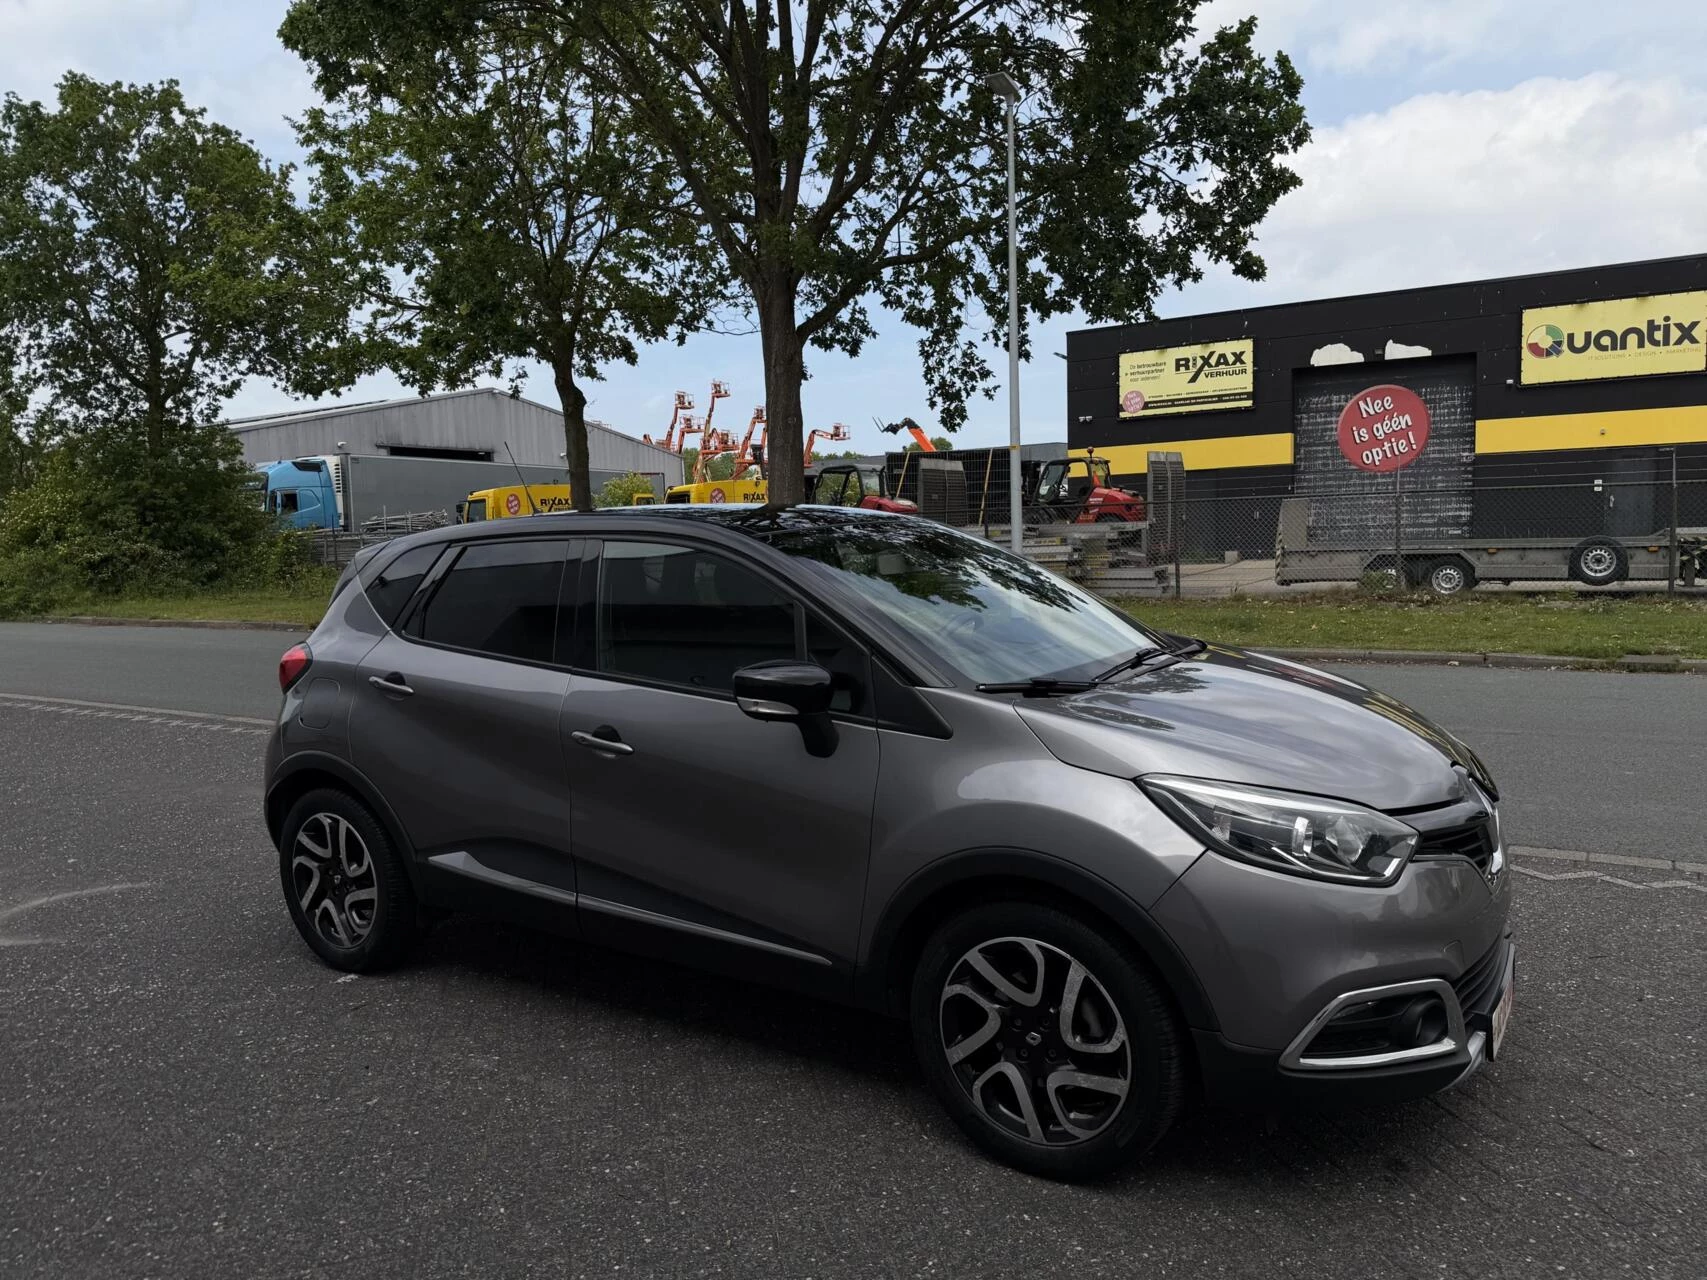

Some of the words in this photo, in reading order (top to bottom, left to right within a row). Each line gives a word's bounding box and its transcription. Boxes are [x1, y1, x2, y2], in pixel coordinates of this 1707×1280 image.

[1175, 351, 1247, 383] RIXAX
[1204, 369, 1247, 379] VERHUUR
[1357, 395, 1394, 418] Nee
[1351, 426, 1369, 444] is
[1371, 412, 1413, 440] géén
[1360, 431, 1417, 466] optie!
[539, 497, 570, 512] RIXAX
[743, 491, 765, 502] RIXAX
